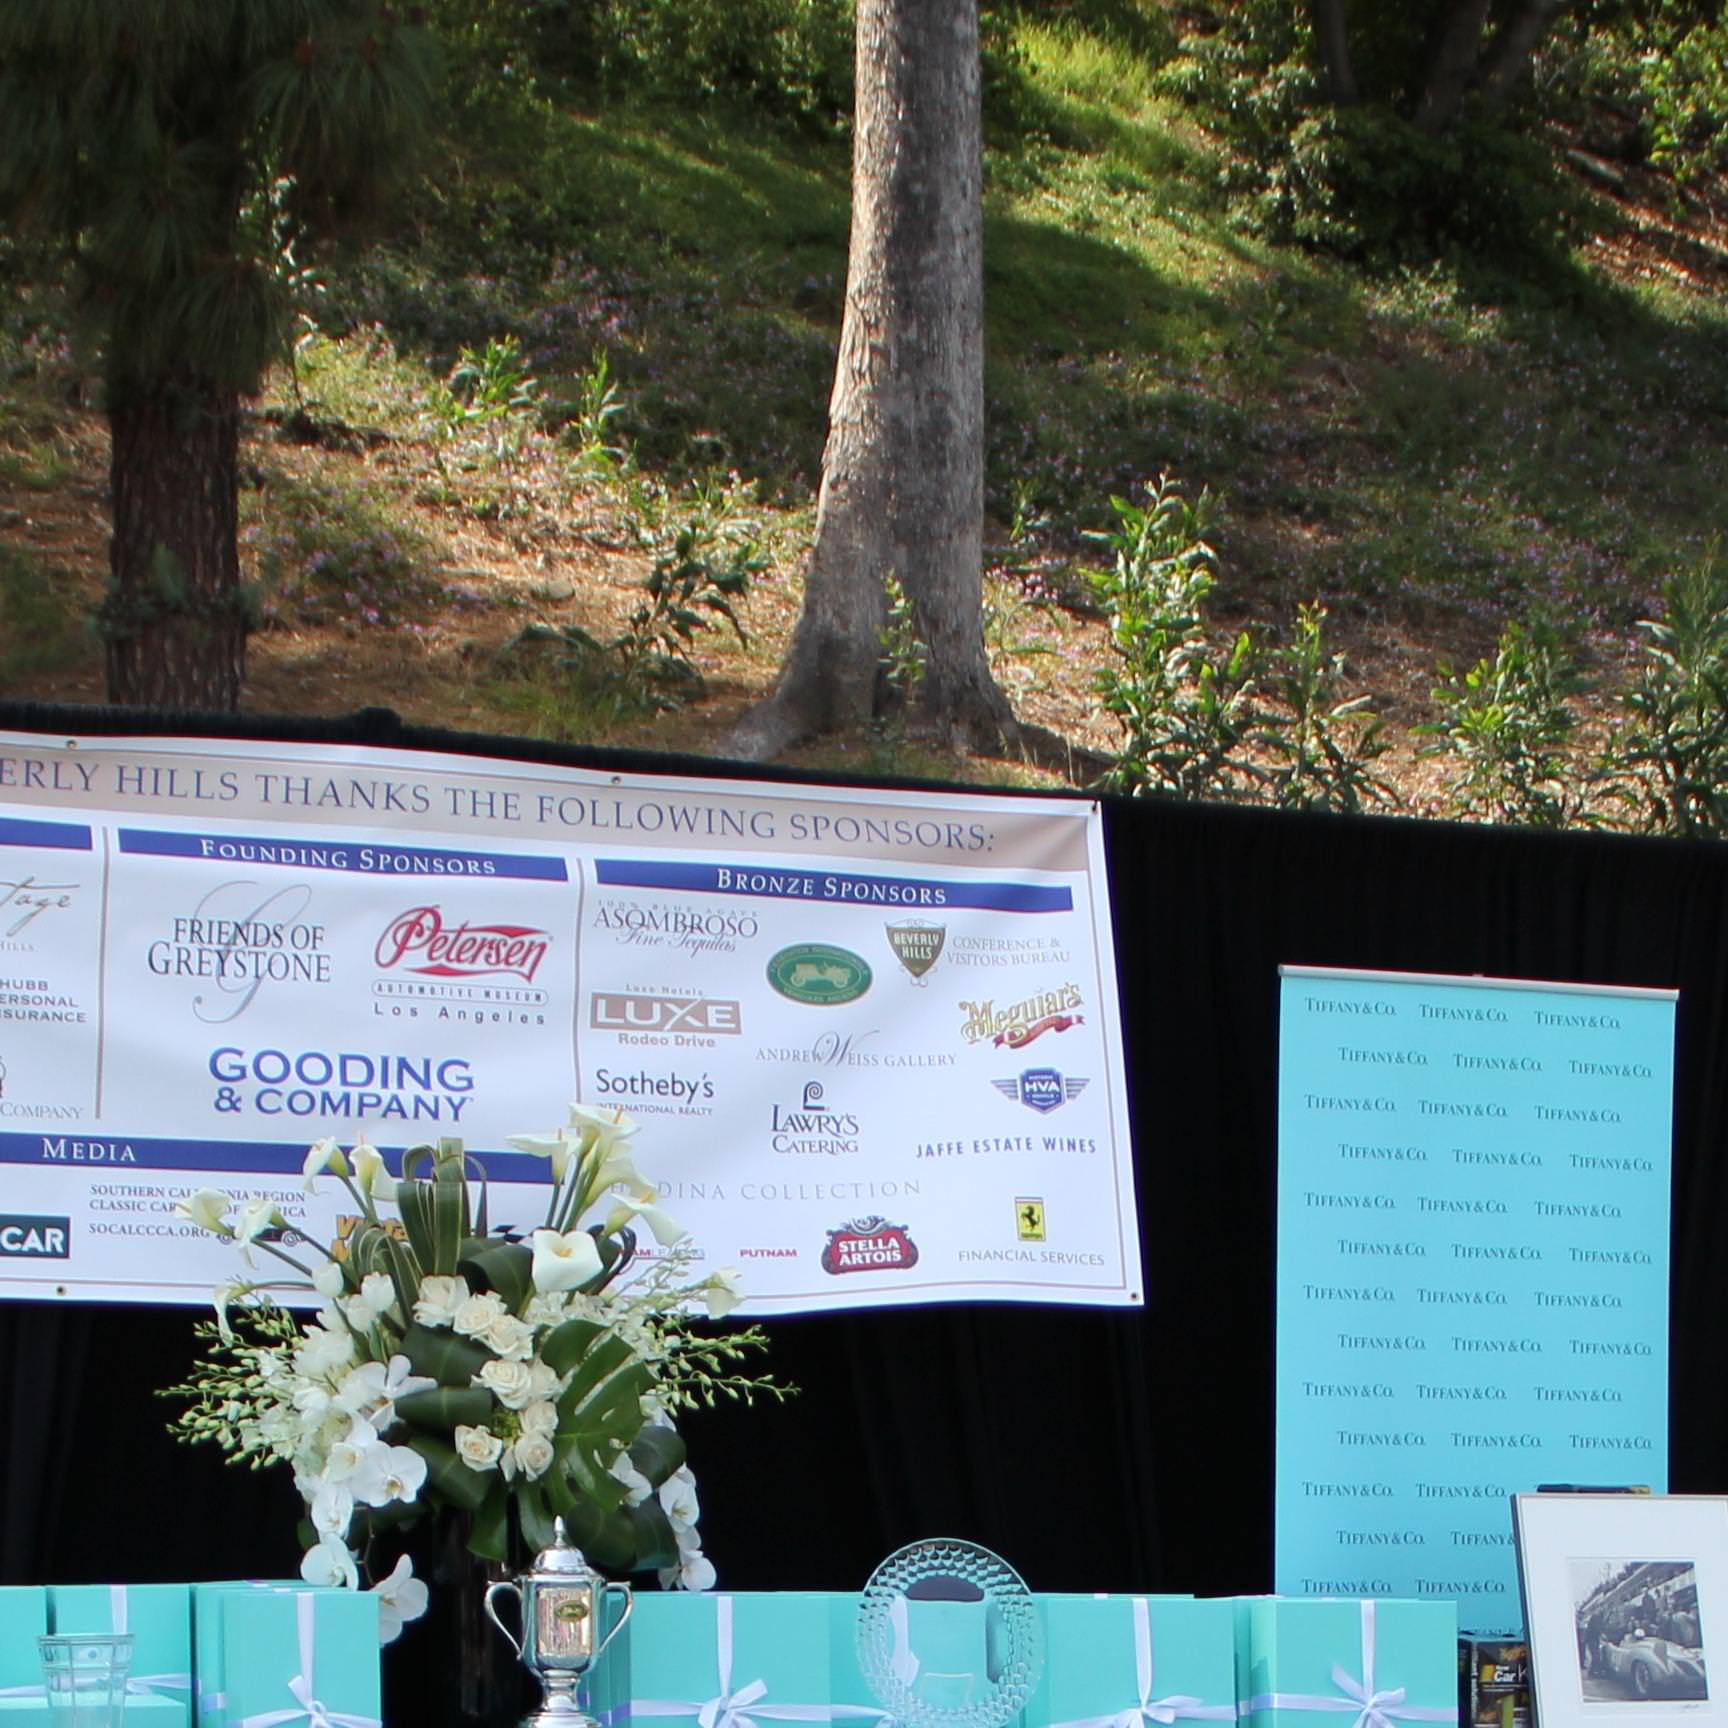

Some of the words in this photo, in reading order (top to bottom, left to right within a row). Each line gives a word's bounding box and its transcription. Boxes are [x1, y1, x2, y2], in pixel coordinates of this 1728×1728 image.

[115, 764, 240, 800] HILLS
[255, 773, 430, 813] THANKS
[444, 786, 521, 821] THE
[536, 792, 775, 839] FOLLOWING
[790, 813, 996, 853] SPONSORS:
[200, 838, 348, 869] FOUNDING
[358, 847, 497, 876] SPONSORS
[717, 867, 815, 897] BRONZE
[823, 877, 947, 906] SPONSORS
[594, 907, 758, 939] ASOMBROSO
[173, 918, 283, 949] FRIENDS
[290, 924, 325, 950] OF
[894, 931, 939, 945] BEVERLY
[375, 905, 548, 984] Petersen
[953, 936, 1047, 950] CONFERENCE
[1050, 937, 1061, 948] &
[902, 947, 932, 960] HILLS
[947, 952, 1008, 967] VISITORS
[1012, 951, 1071, 964] BUREAU
[148, 941, 331, 983] GREYSTONE
[377, 983, 472, 998] AUTOMOTIVE
[484, 990, 542, 1003] MUSEUM
[374, 1002, 419, 1017] Los
[439, 1006, 545, 1025] Angeles
[958, 982, 1084, 1045] Meguiar's
[1305, 998, 1361, 1013] TIFFANY
[1420, 1004, 1473, 1020] TIFFANY
[597, 998, 736, 1031] LUXE
[1534, 1011, 1586, 1027] TIFFANY
[618, 1033, 669, 1047] Rodeo
[674, 1035, 716, 1048] Drive
[756, 1048, 823, 1063] ANDREW
[884, 1053, 957, 1067] GALLERY
[1453, 1053, 1507, 1069] TIFFANY
[209, 1047, 473, 1092] GOODING
[1569, 1060, 1619, 1076] TIFFANY
[596, 1069, 714, 1104] Sotheby's
[1025, 1081, 1060, 1093] HVA
[0, 1102, 84, 1119] COMPANY
[214, 1087, 242, 1113] &
[255, 1089, 472, 1122] COMPANY
[678, 1106, 713, 1116] REALTY
[772, 1104, 858, 1137] LAWRY'S
[42, 1137, 136, 1162] MEDIA
[772, 1135, 858, 1155] CATERING
[916, 1139, 964, 1159] JAFFE
[974, 1137, 1032, 1153] ESTATE
[1042, 1137, 1096, 1154] WINES
[1338, 1144, 1392, 1159] TIFFANY
[90, 1184, 165, 1198] SOUTHERN
[741, 1178, 920, 1201] COLLECTION
[90, 1199, 145, 1212] CLASSIC
[1417, 1197, 1472, 1212] TIFFANY
[89, 1223, 210, 1238] SOCALCCCA.ORG
[839, 1237, 900, 1253] STELLA
[740, 1249, 797, 1258] PUTNAM
[839, 1250, 902, 1266] ARTOIS
[958, 1250, 1036, 1262] FINANCIAL
[1041, 1251, 1104, 1266] SERVICES
[1534, 1292, 1587, 1306] TIFFANY
[1336, 1530, 1390, 1544] TIFFANY
